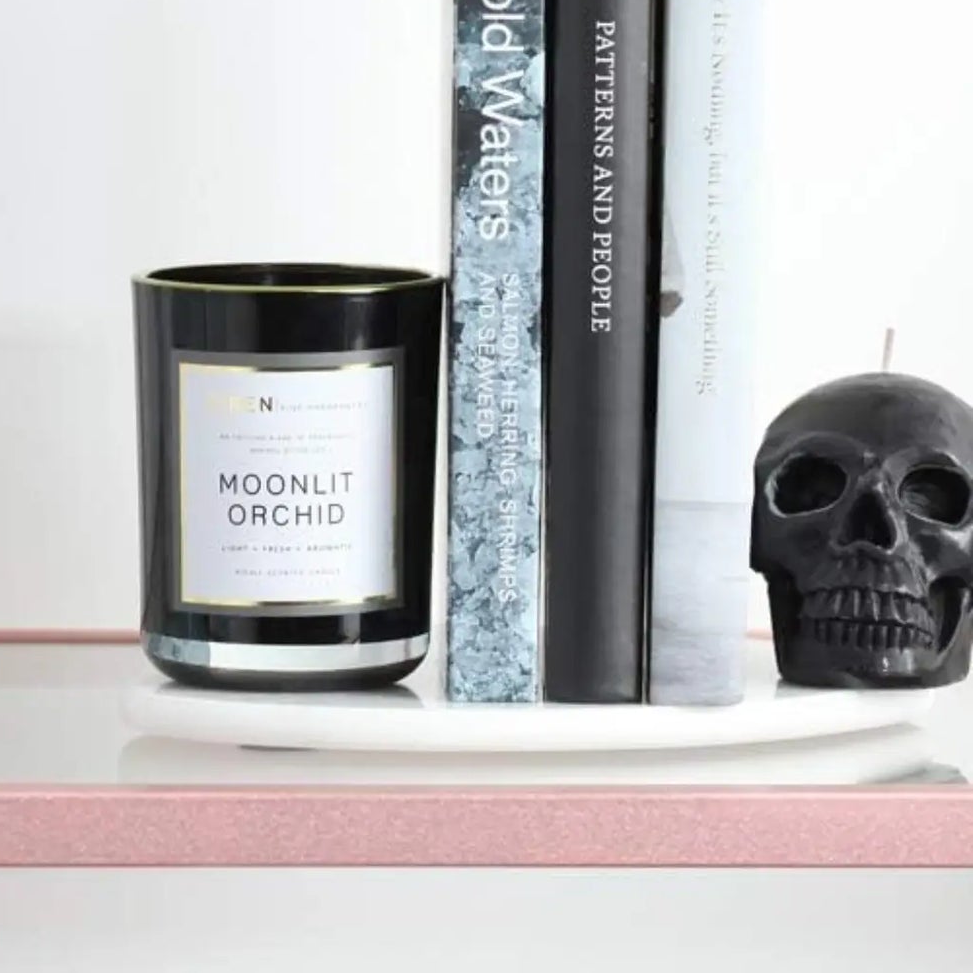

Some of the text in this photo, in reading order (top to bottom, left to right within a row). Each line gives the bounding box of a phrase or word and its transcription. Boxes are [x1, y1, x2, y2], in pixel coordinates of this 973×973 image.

[593, 20, 616, 159] PATTERNS
[480, 70, 525, 240] Waters
[592, 164, 614, 225] AND
[590, 232, 613, 333] PEOPLE
[476, 271, 496, 439] AND SEAWEED
[219, 471, 353, 495] MOONLIT
[228, 503, 345, 526] ORCHID
